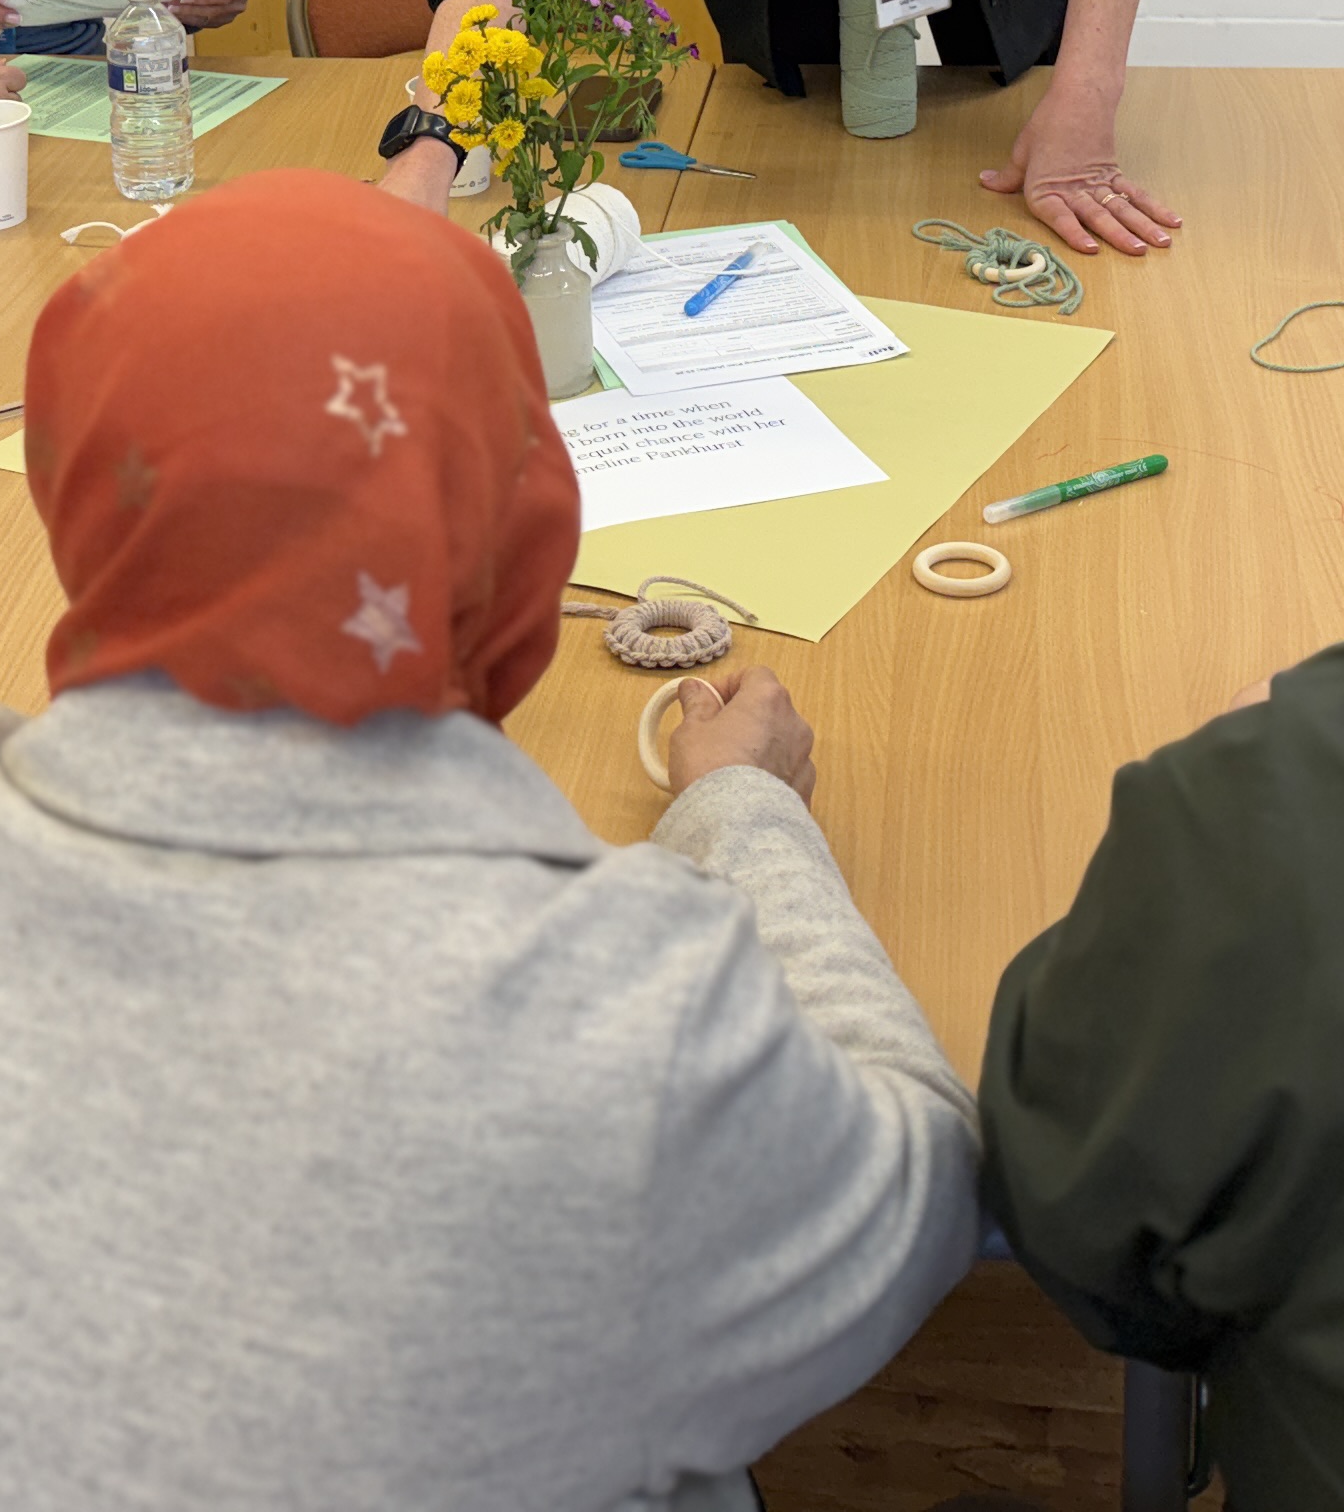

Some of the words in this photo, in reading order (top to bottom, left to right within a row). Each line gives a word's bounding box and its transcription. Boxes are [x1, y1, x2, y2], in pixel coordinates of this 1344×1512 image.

[577, 429, 627, 448] born
[631, 422, 669, 437] into
[672, 416, 705, 430] the
[707, 407, 765, 424] world
[582, 419, 610, 433] for
[615, 416, 628, 426] a
[631, 408, 677, 422] time
[678, 399, 732, 416] when
[574, 454, 643, 477] meline
[645, 438, 746, 462] Pankhurst
[576, 442, 631, 462] equal
[635, 430, 706, 450] chance
[707, 422, 752, 438] with
[754, 415, 787, 432] her
